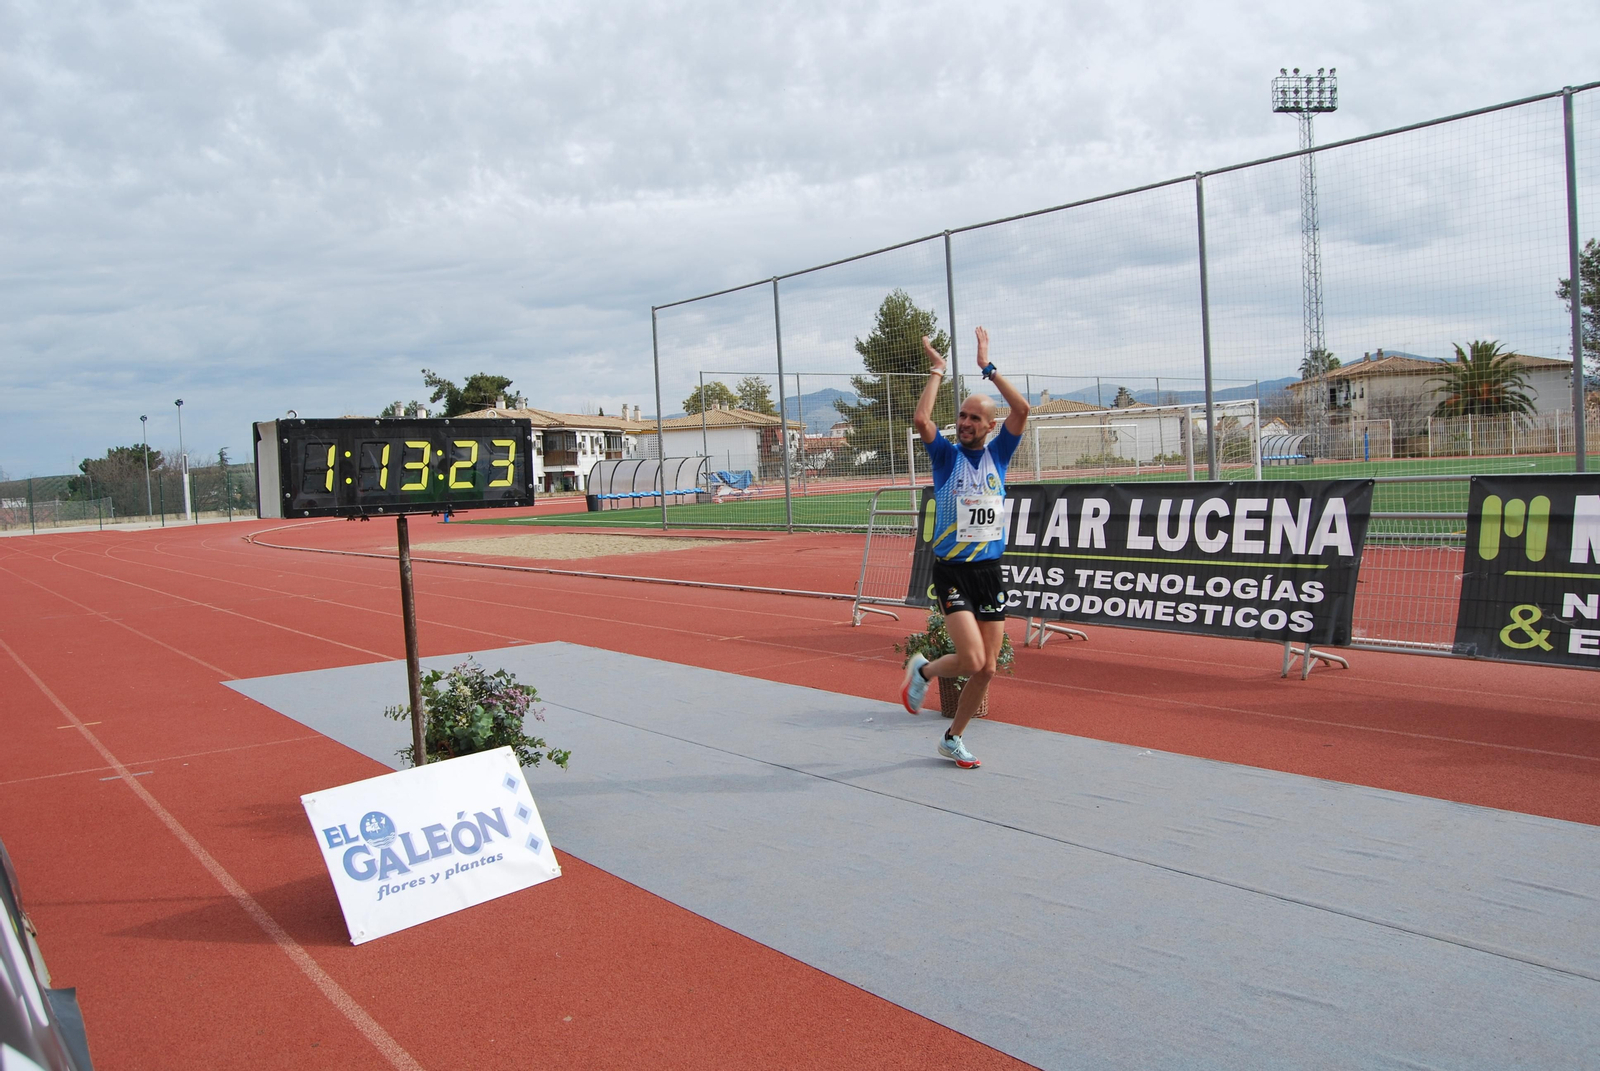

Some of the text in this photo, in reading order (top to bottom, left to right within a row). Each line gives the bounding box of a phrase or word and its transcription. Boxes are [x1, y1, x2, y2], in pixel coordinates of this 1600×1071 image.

[325, 439, 516, 492] 1:13:23
[968, 507, 996, 526] 709
[1003, 497, 1354, 557] ILAR LUCENA
[1000, 565, 1325, 603] EVAS TECNOLOGÍAS
[1004, 589, 1314, 633] CTRODOMESTICOS
[322, 823, 360, 849] EL
[342, 806, 511, 882] GALEÓN
[376, 852, 504, 901] flores y plantas
